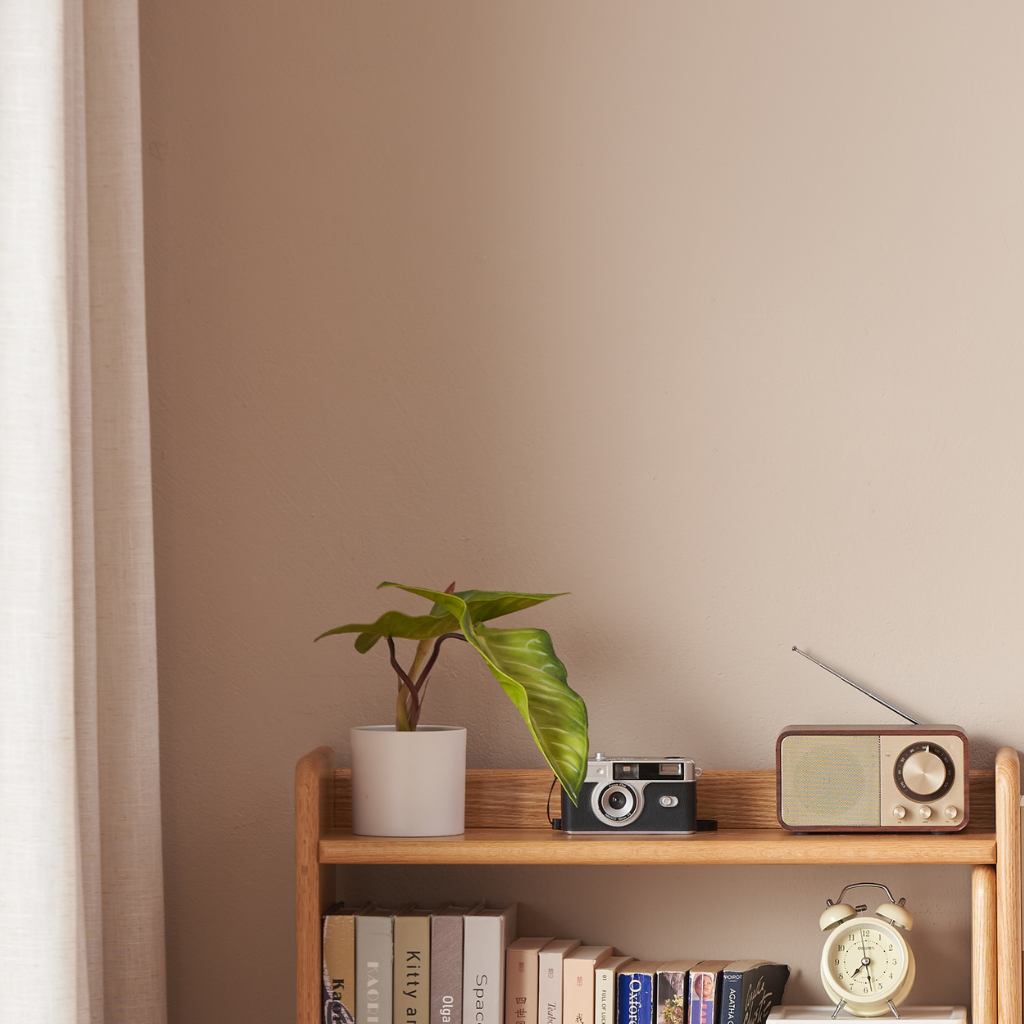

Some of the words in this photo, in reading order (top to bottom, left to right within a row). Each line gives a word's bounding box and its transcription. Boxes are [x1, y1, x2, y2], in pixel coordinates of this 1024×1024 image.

[403, 951, 421, 999] Kitty
[366, 962, 380, 1023] KAORI
[601, 1003, 607, 1011] OF
[727, 988, 736, 1020] AGATHA
[439, 995, 454, 1023] Olga
